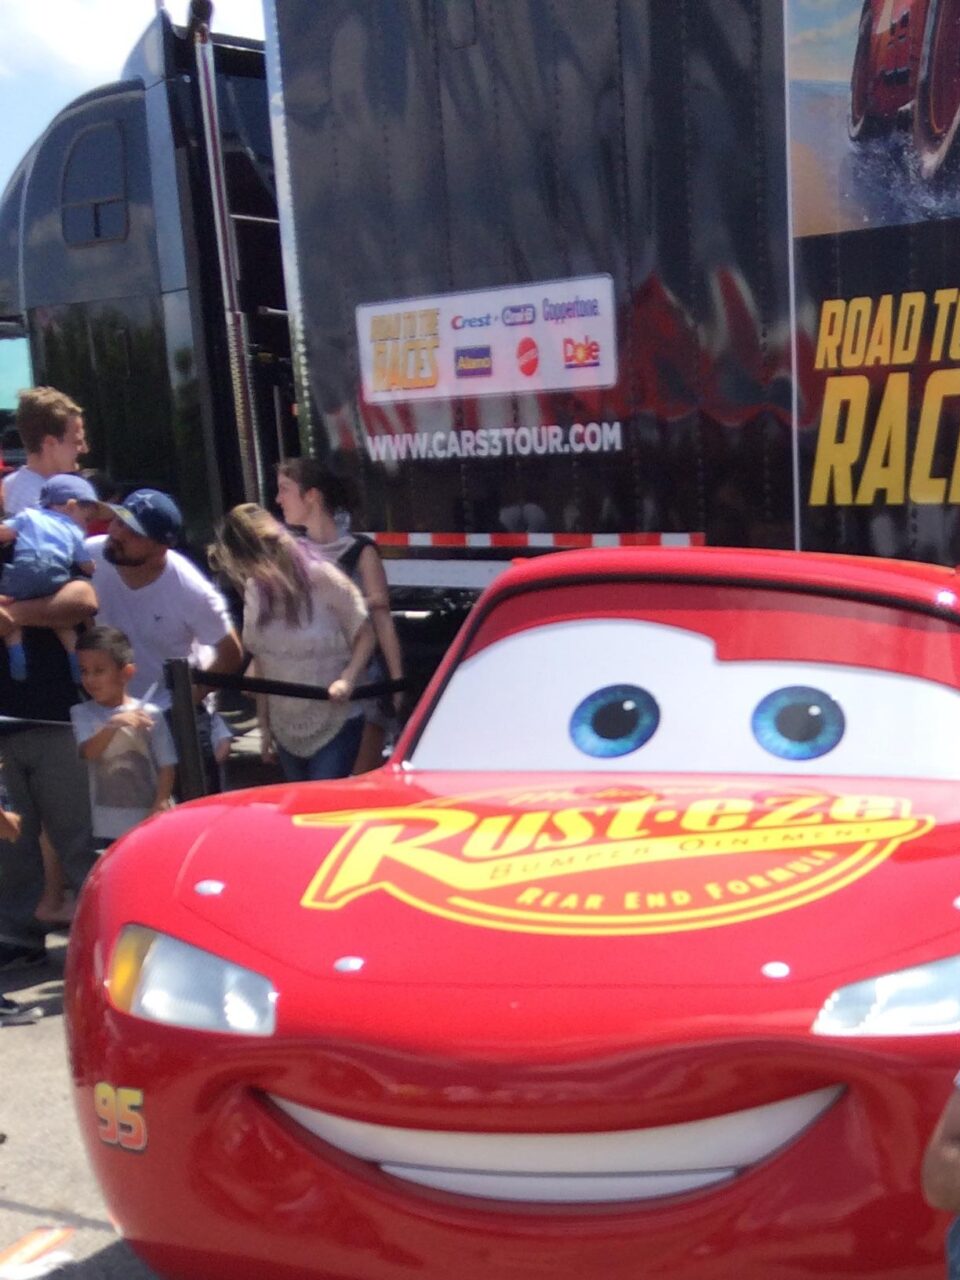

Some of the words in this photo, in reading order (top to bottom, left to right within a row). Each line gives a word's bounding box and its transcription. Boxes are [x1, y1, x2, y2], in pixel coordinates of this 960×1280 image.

[451, 313, 491, 330] Crest
[815, 293, 926, 370] ROAD
[563, 335, 600, 367] Dole
[367, 421, 622, 462] WWW.CARS3TOUR.COM
[516, 887, 604, 911] REAR
[624, 889, 692, 911] END
[93, 1080, 148, 1153] 95
